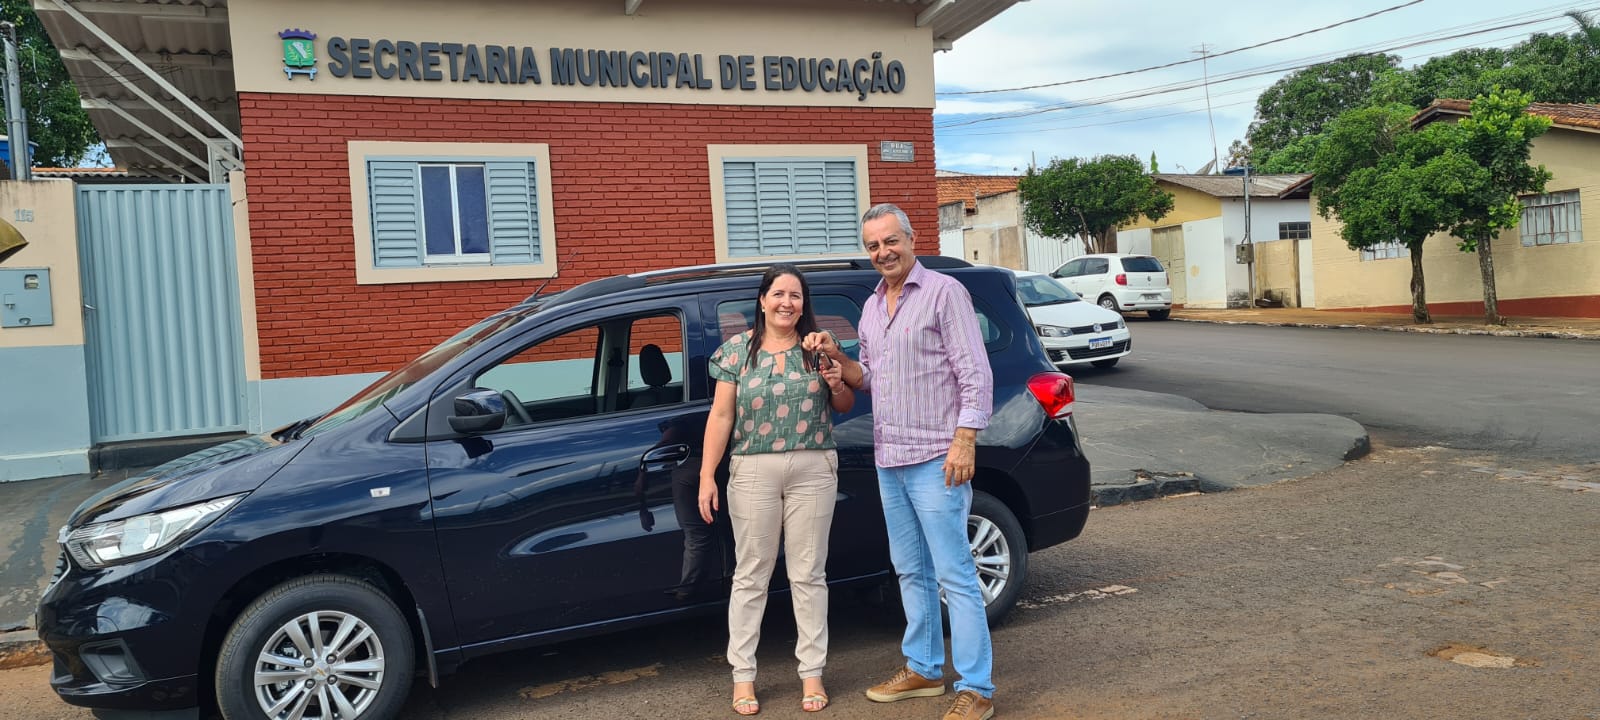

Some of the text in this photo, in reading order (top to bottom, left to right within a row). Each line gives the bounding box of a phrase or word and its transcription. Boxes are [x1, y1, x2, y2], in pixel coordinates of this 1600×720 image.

[327, 36, 906, 101] SECRETARIA MUNICIPAL DE EDUCAÇÃO
